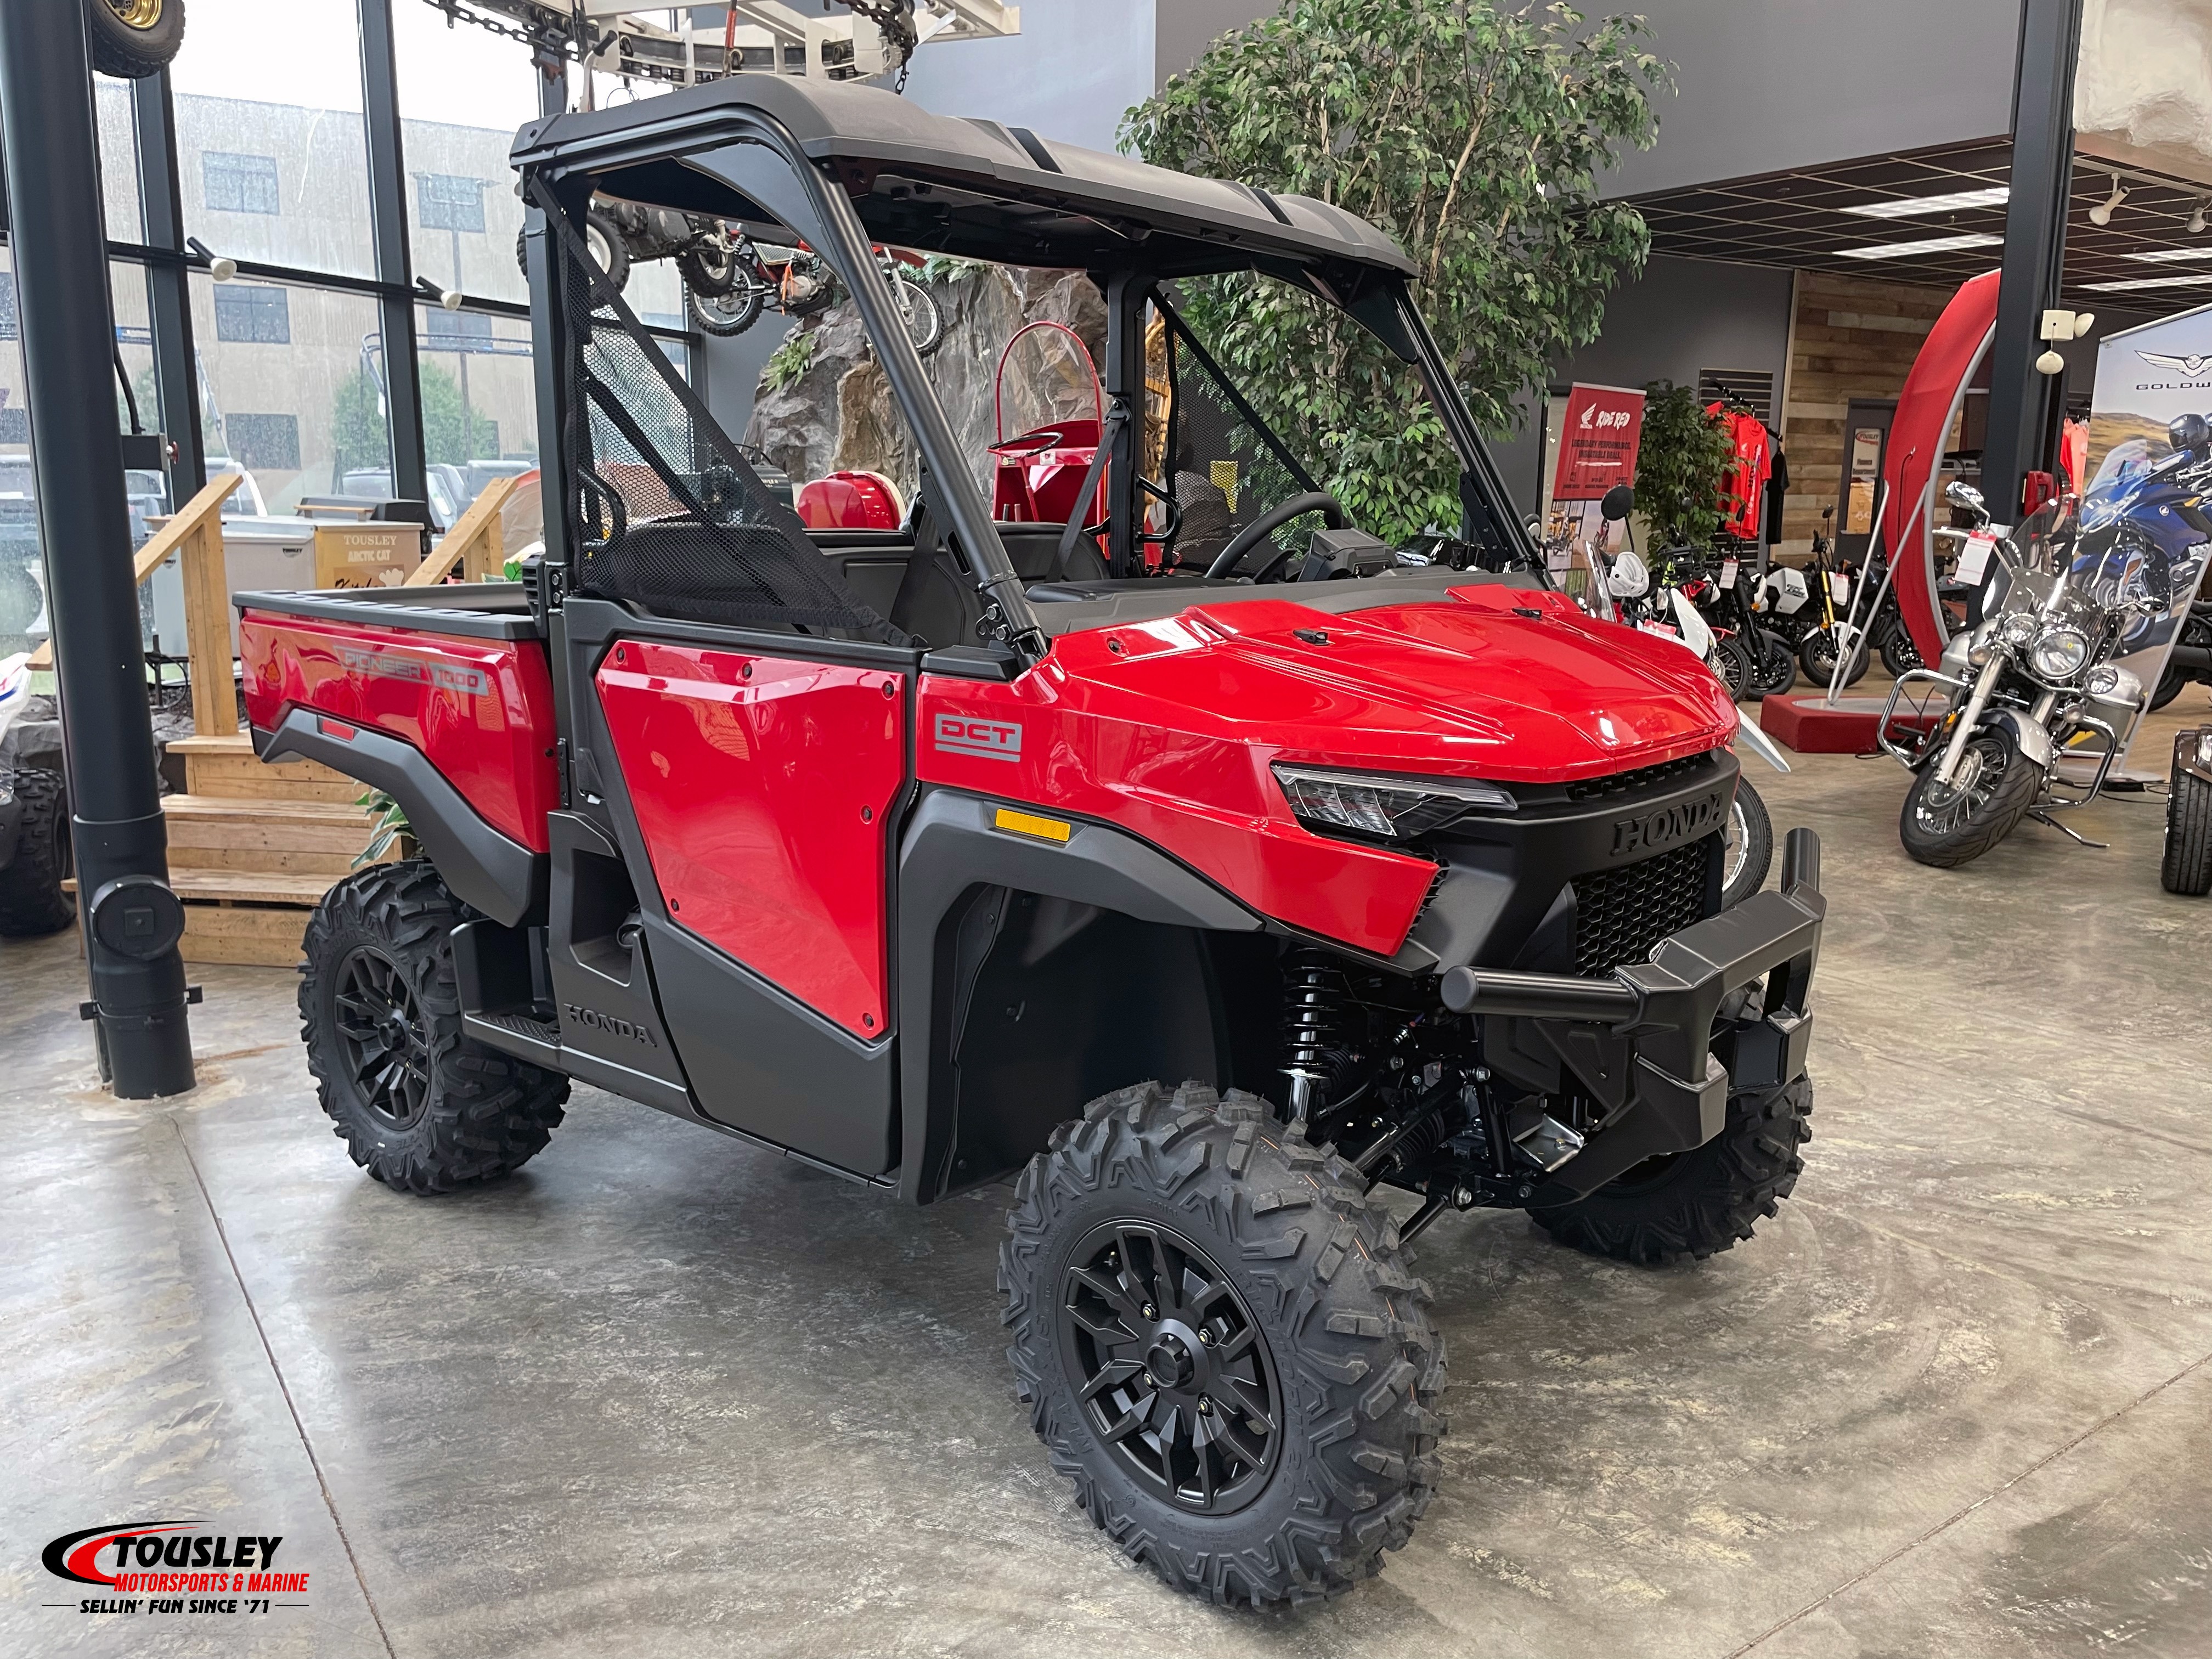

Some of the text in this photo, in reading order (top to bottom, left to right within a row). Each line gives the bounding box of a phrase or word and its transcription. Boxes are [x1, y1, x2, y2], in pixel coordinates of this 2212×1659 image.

[2136, 382, 2211, 390] GOLDW
[1595, 410, 1630, 431] RIDE RED
[344, 535, 397, 545] TOUSLEY
[348, 549, 391, 562] ARCTIC CAT
[345, 651, 479, 688] PIONEER 1000
[941, 719, 1015, 744] DCT
[1610, 789, 1723, 856] HONDA
[563, 1003, 657, 1048] HONDA
